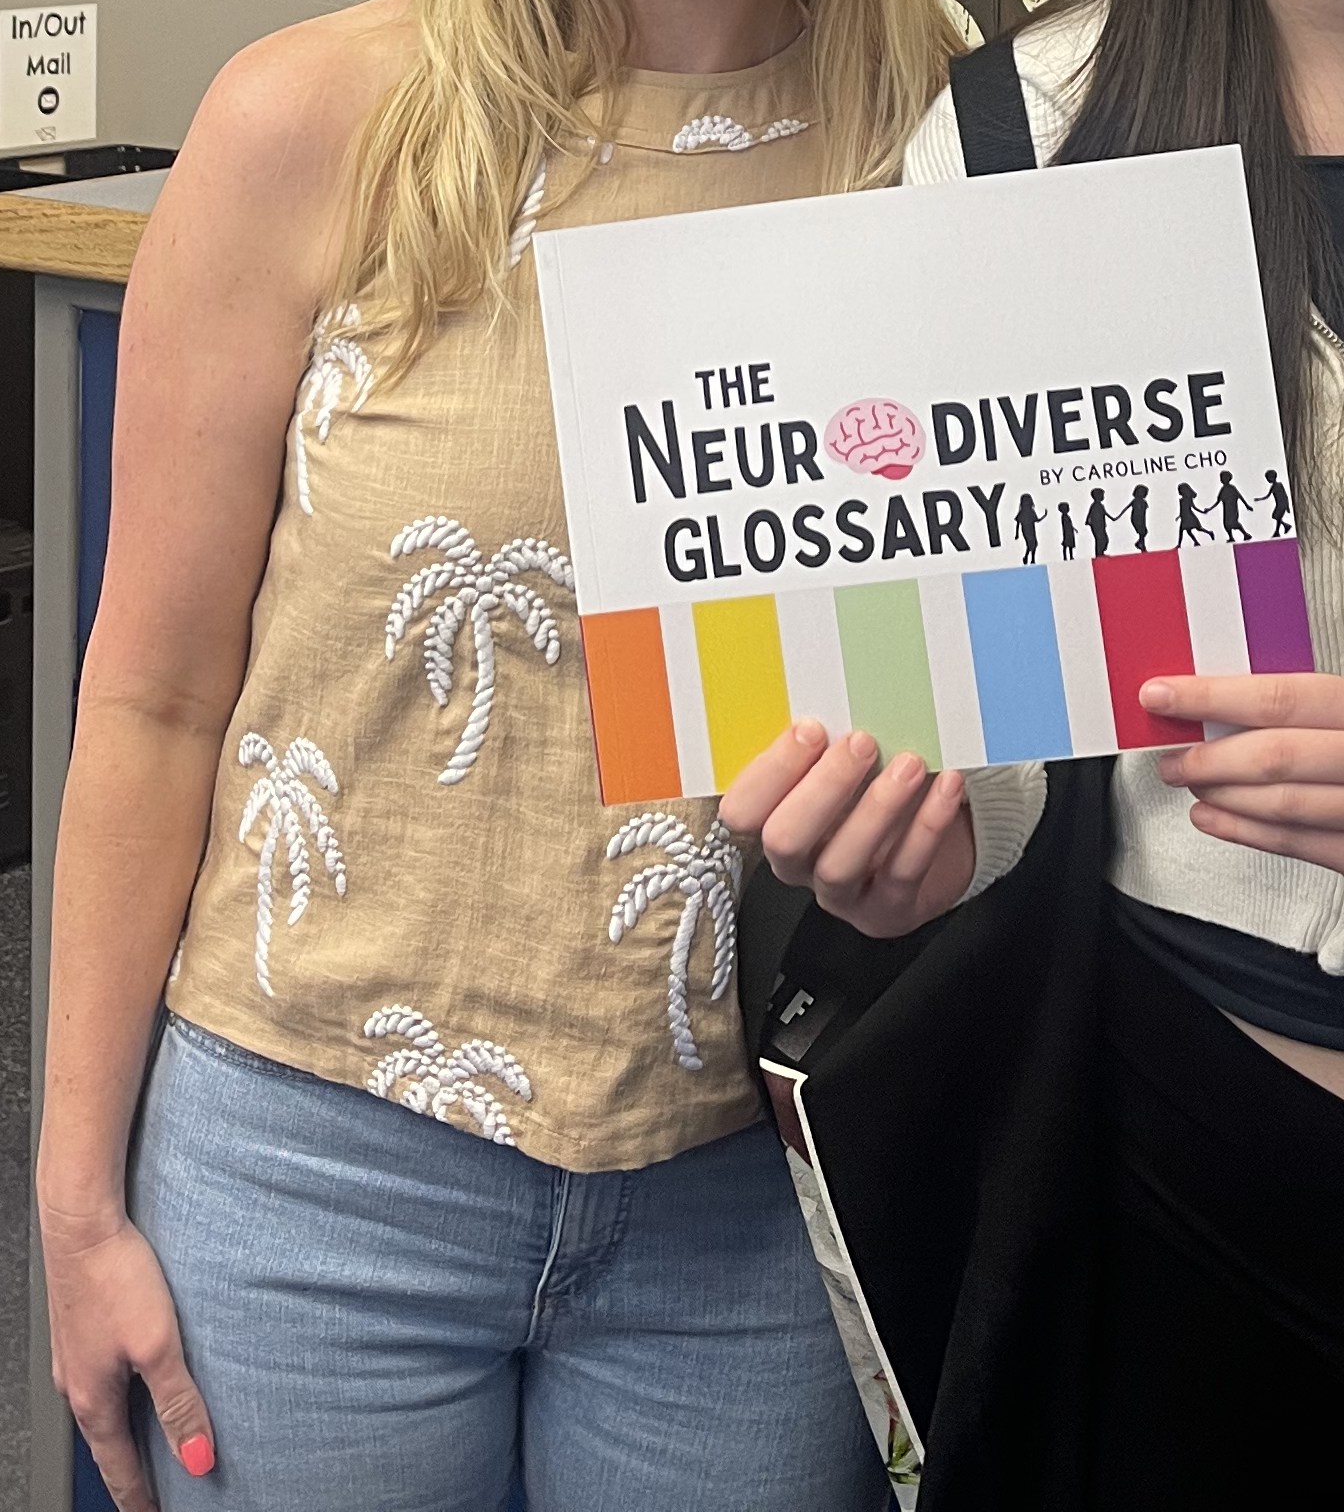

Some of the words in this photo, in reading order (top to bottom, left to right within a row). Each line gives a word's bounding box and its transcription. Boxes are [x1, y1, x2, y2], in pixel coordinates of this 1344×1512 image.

[12, 11, 86, 39] In/Out
[26, 52, 71, 76] Mail
[694, 362, 775, 410] THE
[1040, 467, 1064, 486] BY
[1072, 455, 1177, 482] CAROLINE
[1184, 450, 1227, 470] CHO
[664, 482, 1007, 583] GLOSSARY
